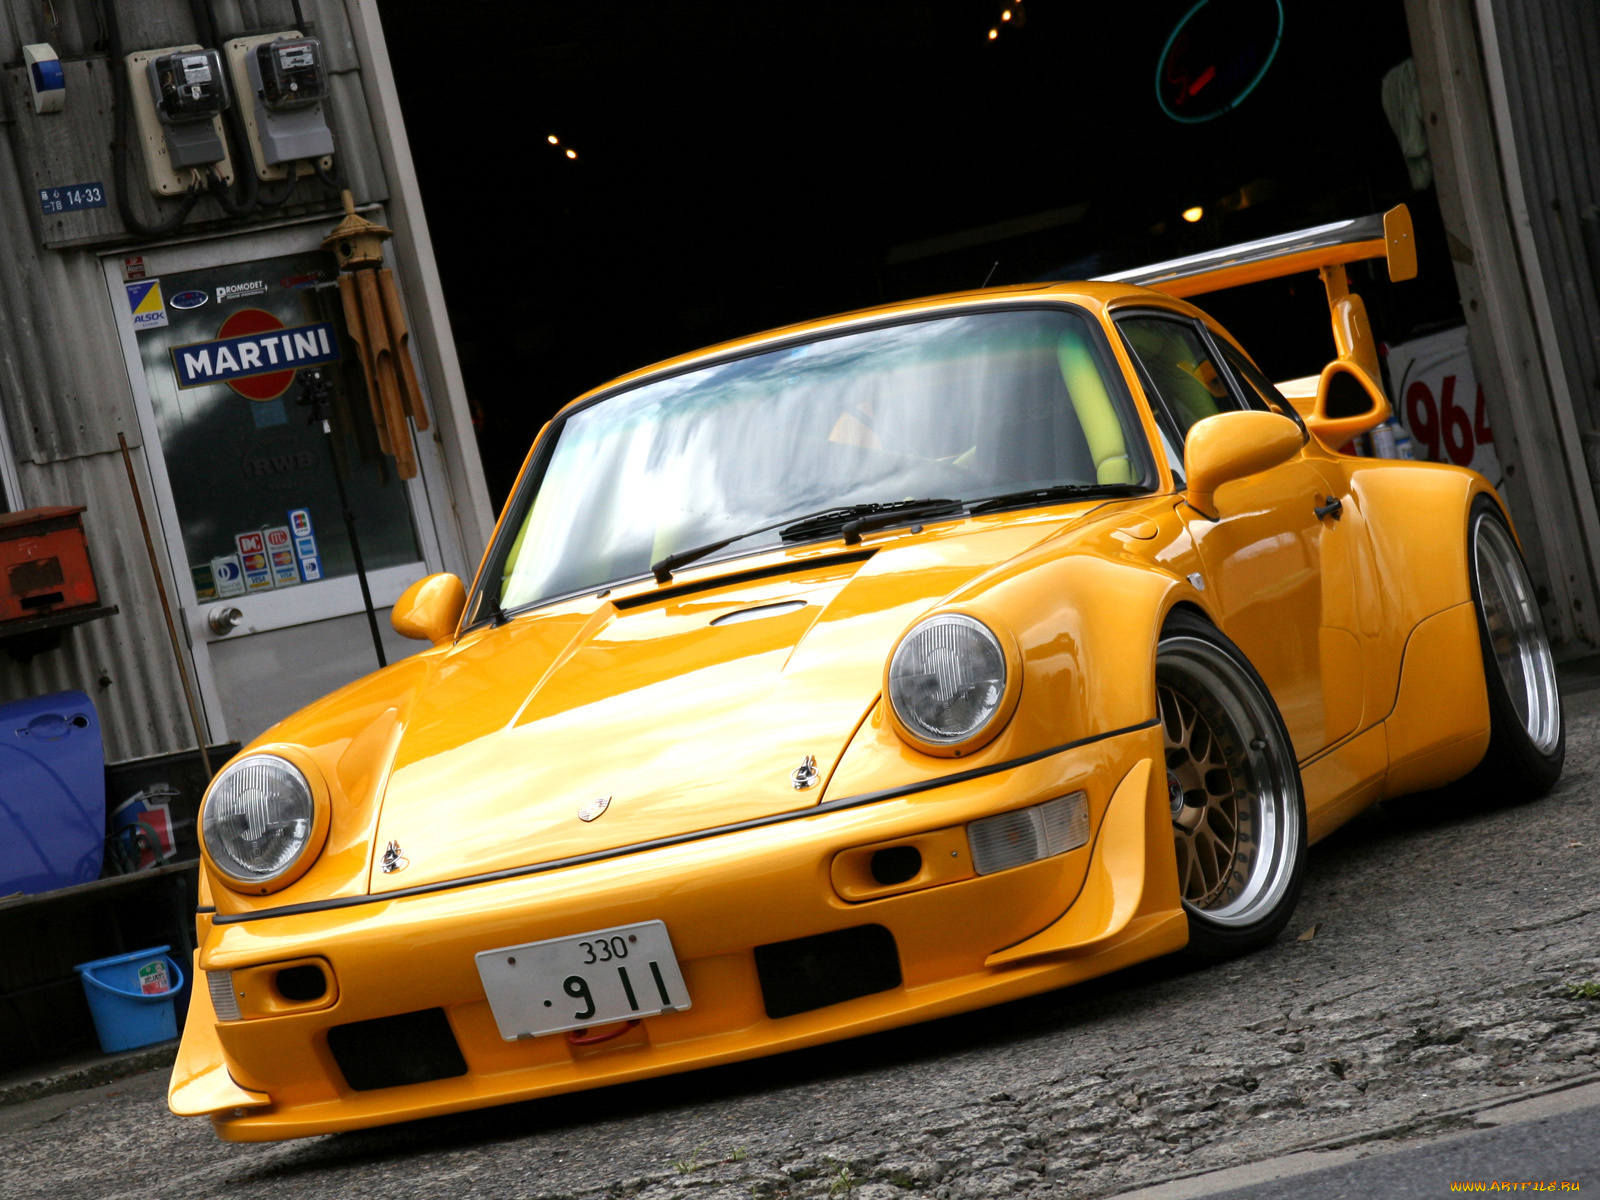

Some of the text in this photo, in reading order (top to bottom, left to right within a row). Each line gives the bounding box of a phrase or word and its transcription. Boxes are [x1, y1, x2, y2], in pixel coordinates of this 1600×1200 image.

[66, 188, 102, 205] 14-33
[215, 280, 264, 304] PROMODET
[134, 312, 165, 324] ALSOK
[183, 328, 331, 380] MARTINI
[578, 935, 628, 965] 330
